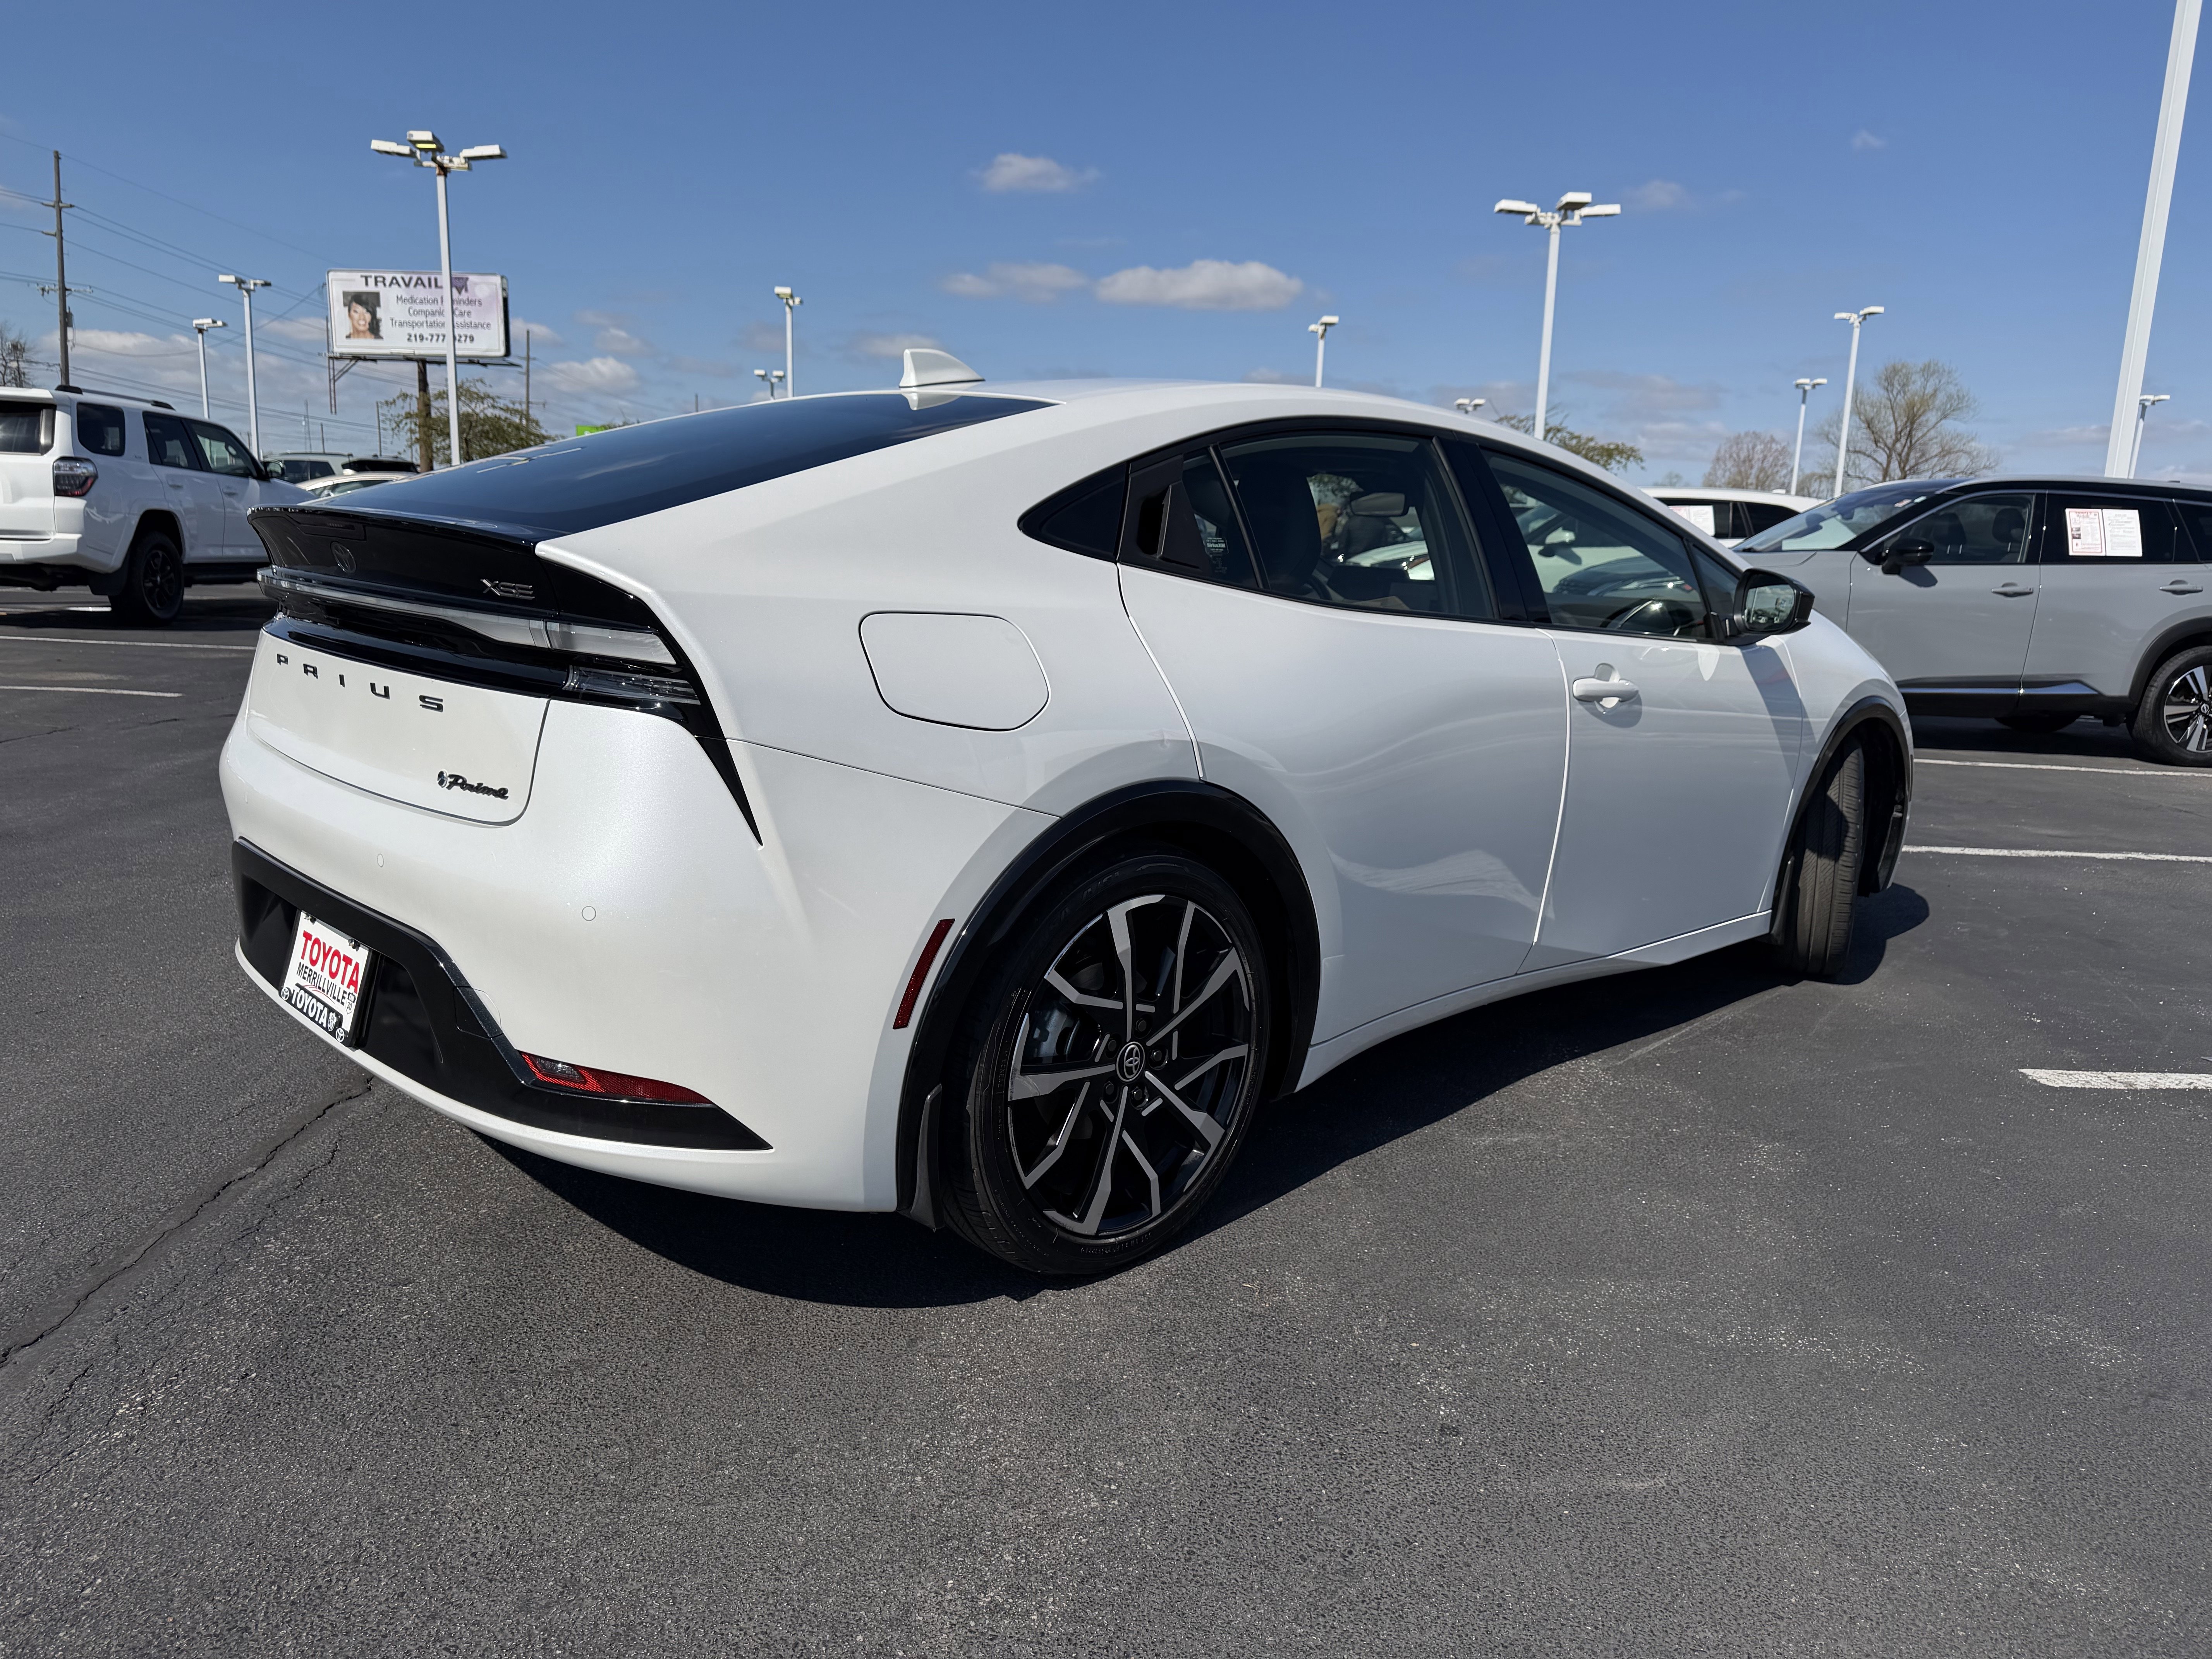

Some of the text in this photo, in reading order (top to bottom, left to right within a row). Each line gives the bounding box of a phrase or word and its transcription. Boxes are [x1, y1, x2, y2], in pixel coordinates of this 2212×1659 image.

[396, 294, 438, 306] Medication
[454, 307, 472, 318] Care
[455, 319, 491, 330] ssistance
[480, 579, 535, 600] XSE
[276, 653, 444, 713] PRIUS
[446, 774, 508, 800] Prime
[301, 930, 360, 994] TOYOTA
[297, 962, 347, 1006] MERRILLVILLE
[292, 986, 328, 1028] TOYOTA
